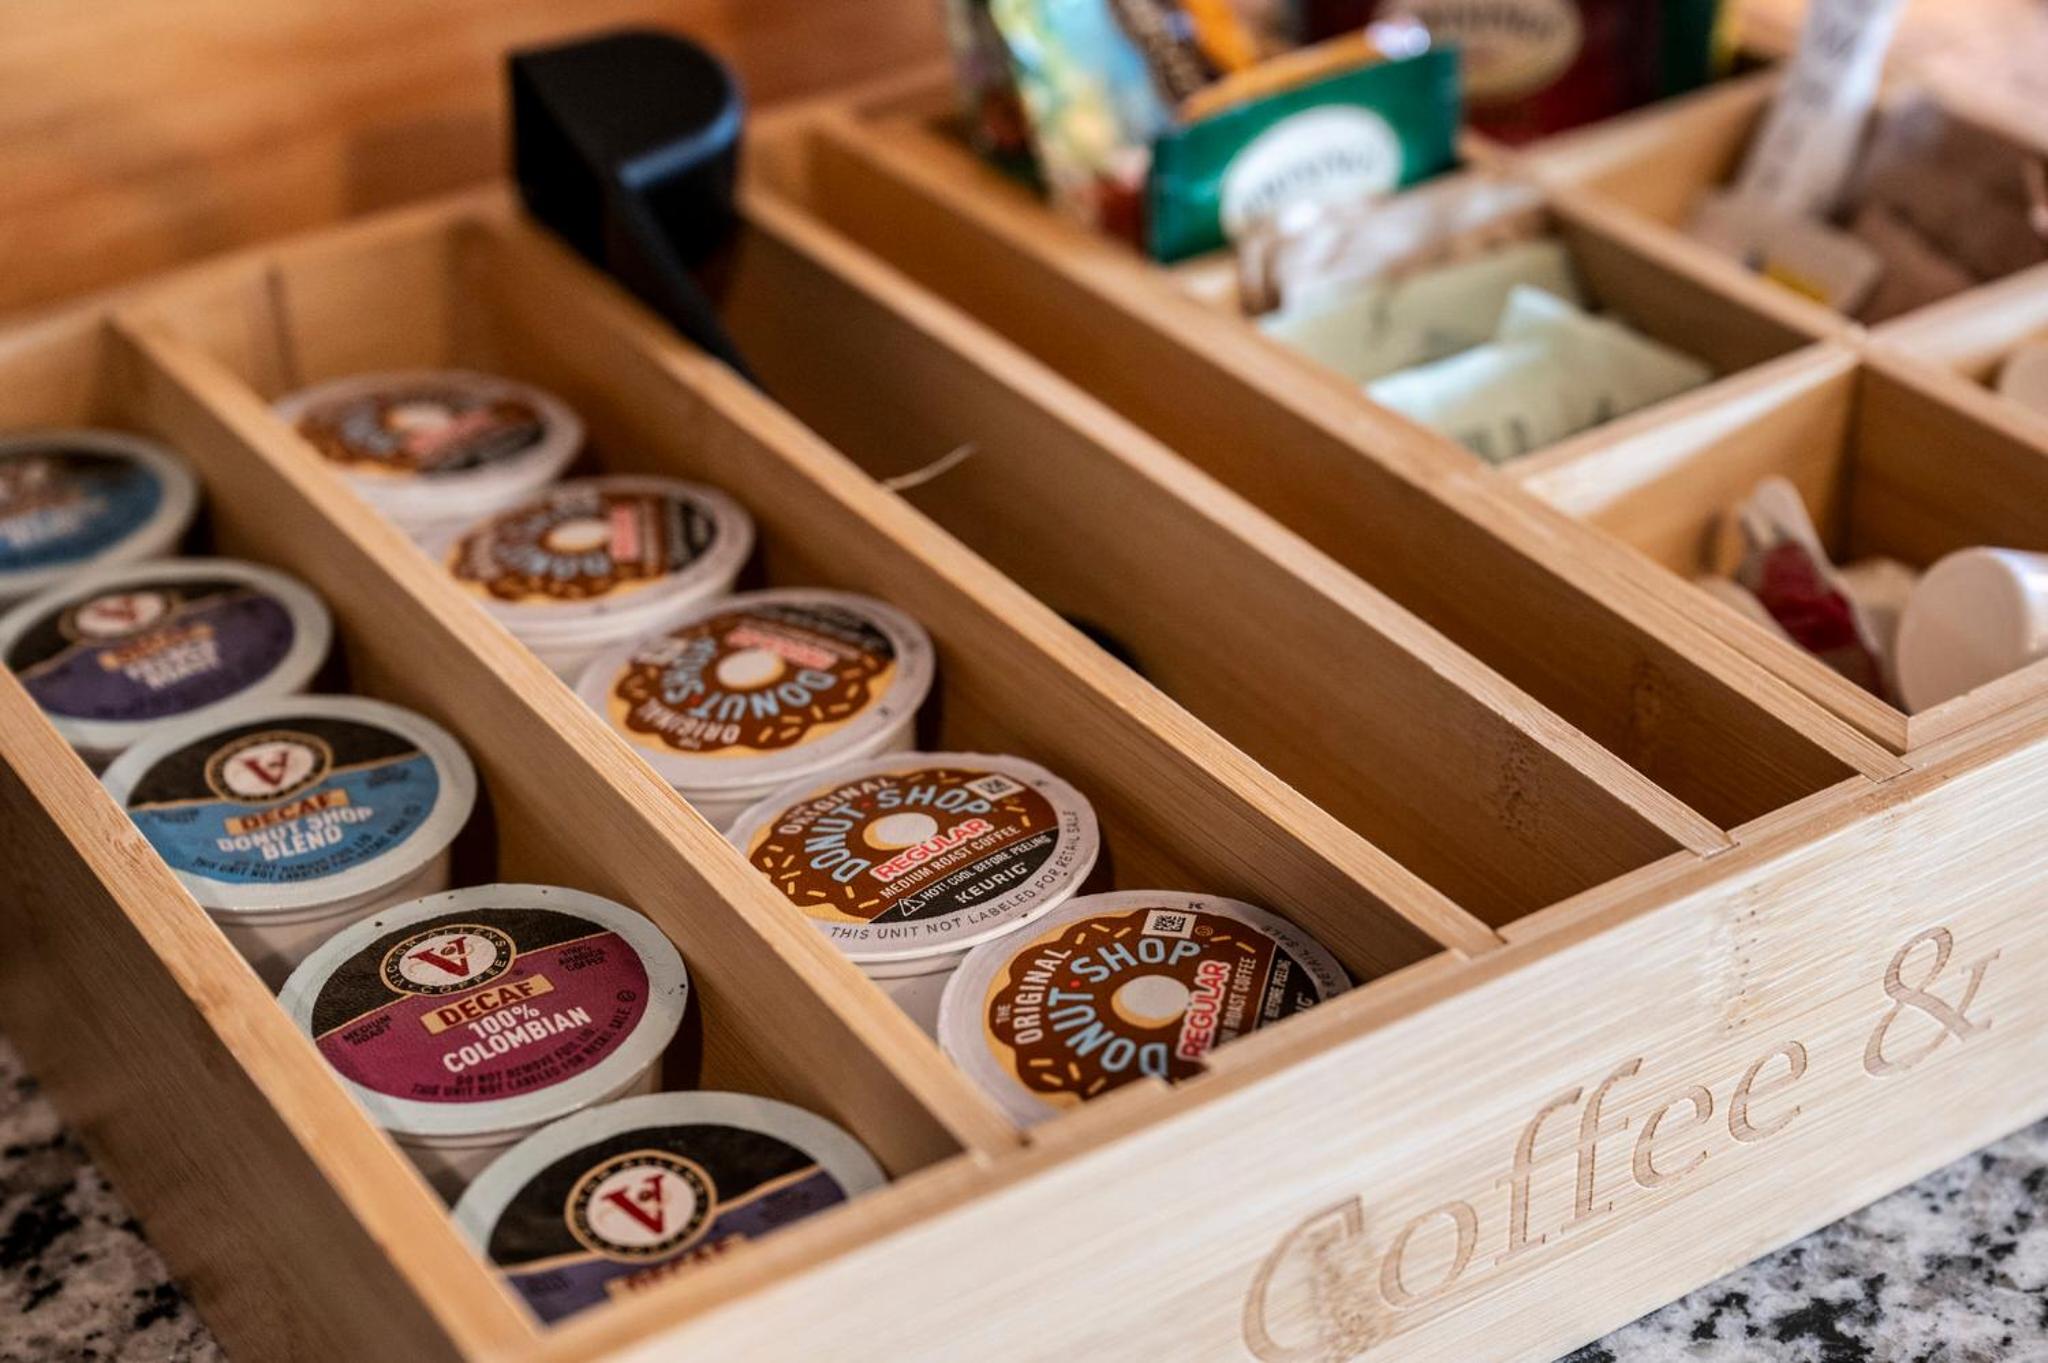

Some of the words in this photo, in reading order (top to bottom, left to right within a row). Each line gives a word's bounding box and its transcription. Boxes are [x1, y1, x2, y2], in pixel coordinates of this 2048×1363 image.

[688, 670, 838, 721] DONUT
[216, 818, 300, 854] DONUT
[308, 805, 375, 831] SHOP
[241, 793, 331, 831] DECAF
[778, 777, 897, 834] ORIGINAL
[261, 826, 343, 861] BLEND
[804, 802, 872, 883] DONUT
[876, 785, 992, 815] SHOP
[872, 818, 993, 881] REGULAR
[830, 925, 870, 940] THIS
[876, 925, 919, 940] UNIT
[926, 917, 963, 935] NOT
[967, 889, 1036, 924] LABELED
[1035, 868, 1060, 889] FOR
[1055, 834, 1080, 870] RETAIL
[879, 867, 934, 899] MEDIUM
[931, 848, 973, 872] ROAST
[973, 825, 1021, 851] COFFEE
[920, 883, 950, 901] HOT!
[949, 870, 976, 887] COOL
[973, 852, 1013, 873] BEFORE
[1012, 835, 1052, 857] PEELING
[955, 863, 1028, 904] KEURIG
[408, 936, 470, 977] V
[1070, 937, 1200, 983] SHOP
[1232, 956, 1257, 992] COFFEE
[436, 981, 536, 1027] DECAF
[468, 1003, 541, 1040] 100%
[1013, 949, 1073, 1044] ORIGINAL
[1177, 960, 1231, 1059] REGULAR
[1223, 991, 1247, 1028] ROAST
[342, 1014, 392, 1041] MEDIUM
[442, 1006, 593, 1073] COLOMBIAN
[1047, 986, 1168, 1078] DONUT
[478, 1072, 504, 1085] NOT
[478, 1083, 504, 1096] NOT
[1242, 1040, 1808, 1363] Coffee
[1864, 926, 2001, 1078] &
[601, 1174, 665, 1234] V
